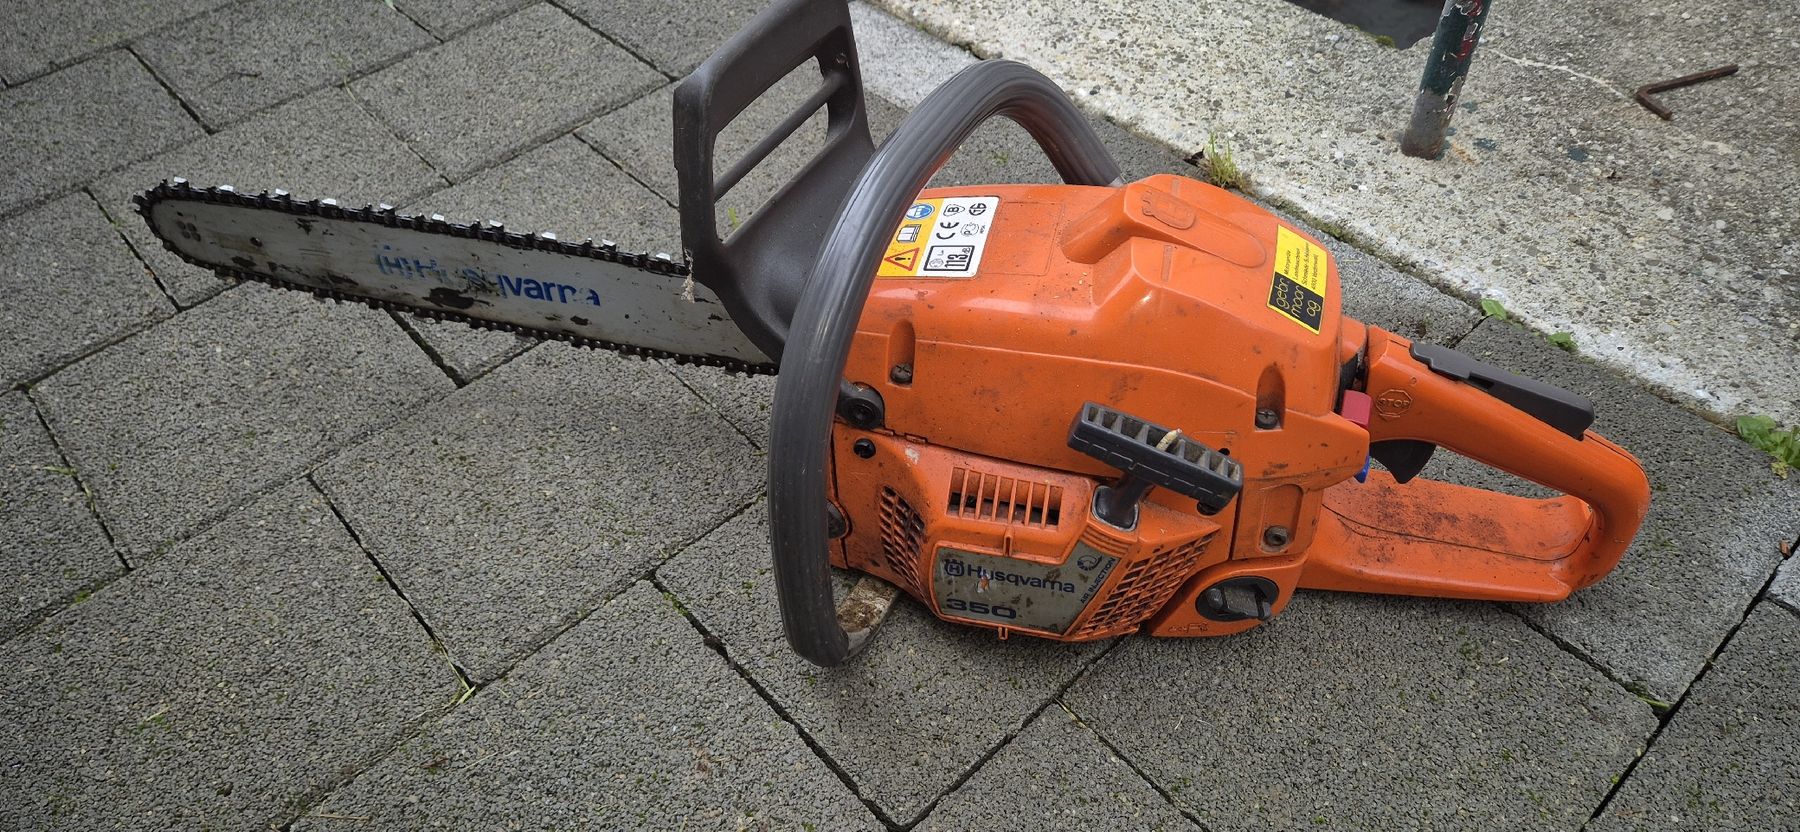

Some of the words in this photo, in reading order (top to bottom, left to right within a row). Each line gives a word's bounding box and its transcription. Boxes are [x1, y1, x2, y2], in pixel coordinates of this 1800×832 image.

[944, 254, 969, 268] 113
[1306, 300, 1321, 317] ag
[967, 564, 1076, 594] Husqvarna
[1080, 592, 1089, 604] AIR
[1088, 557, 1116, 592] INJECTION
[946, 598, 1017, 620] 350
